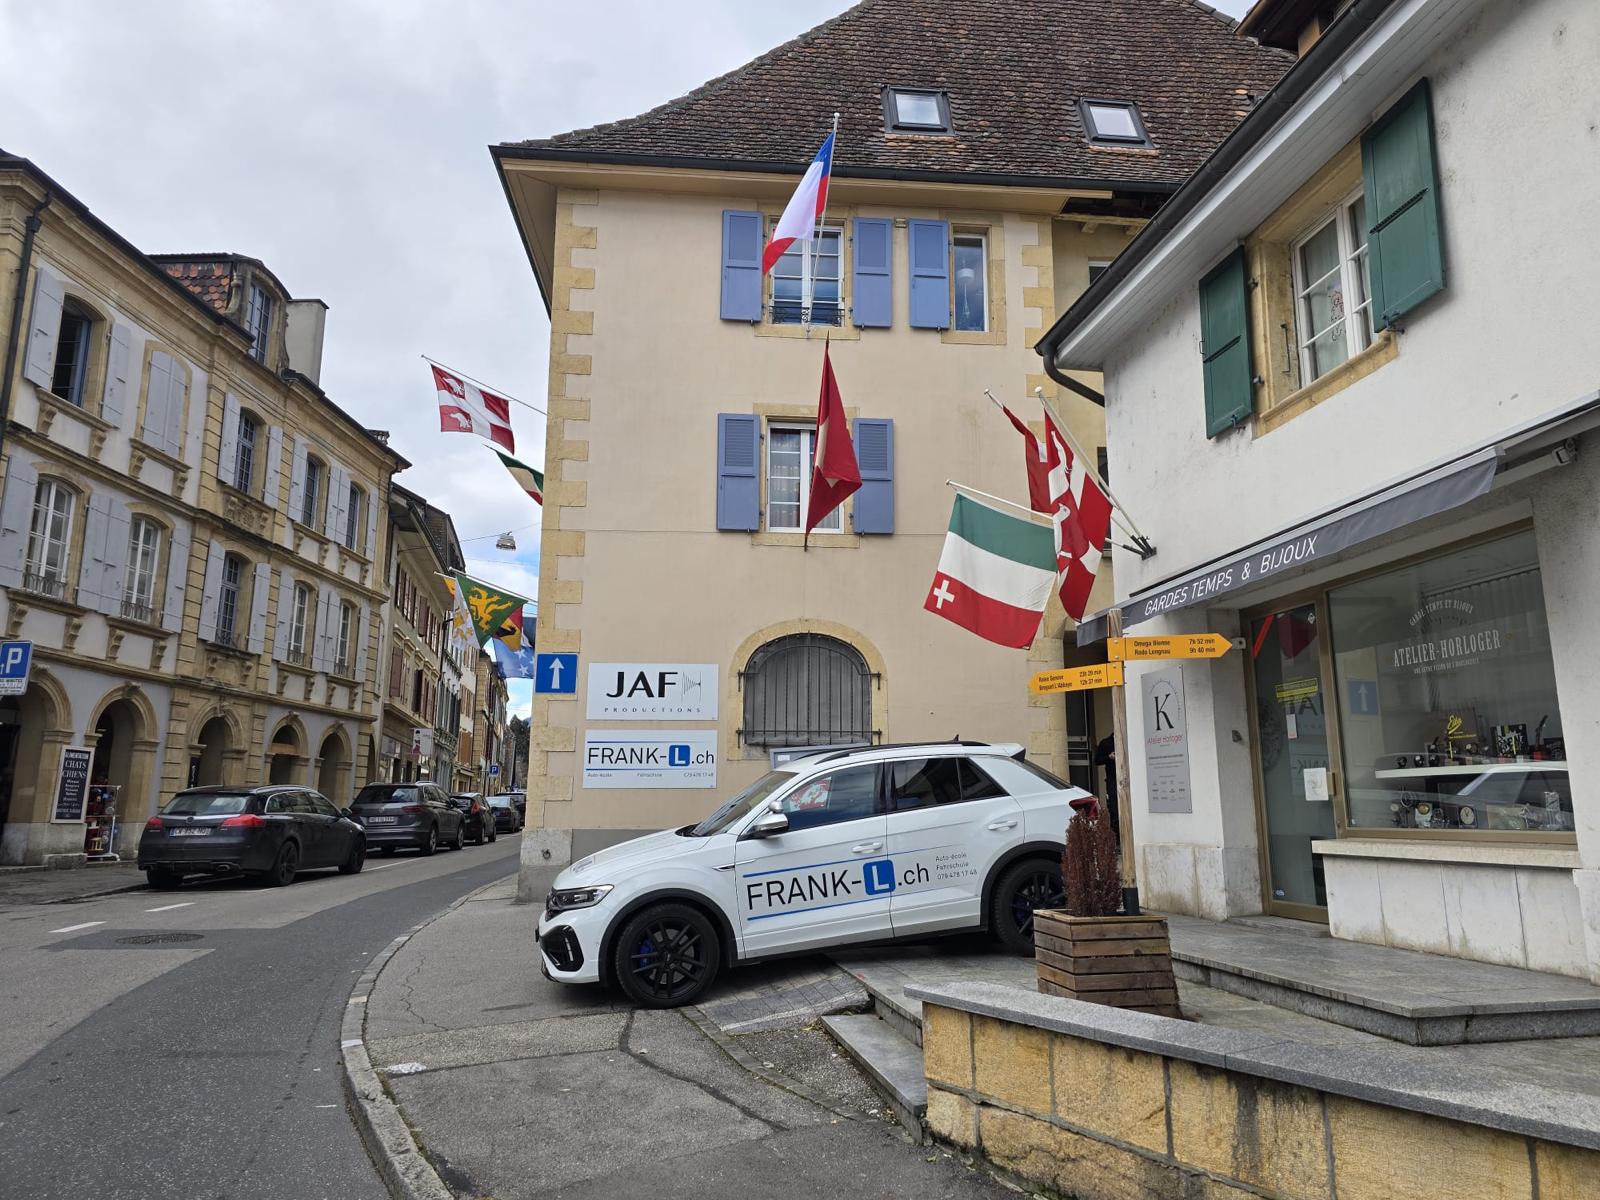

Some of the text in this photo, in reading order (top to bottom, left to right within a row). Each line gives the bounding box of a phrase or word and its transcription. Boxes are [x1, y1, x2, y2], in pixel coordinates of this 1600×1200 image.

[1144, 534, 1318, 616] GARDES TEMPS & BIJOUX
[1425, 600, 1444, 614] TEMPS
[1444, 599, 1452, 609] ET
[1453, 599, 1474, 614] BIJOUX
[1133, 640, 1152, 648] Omega
[1134, 648, 1148, 656] Rado
[1148, 647, 1171, 656] Lengnau
[5, 647, 23, 674] P
[605, 670, 679, 698] JAF
[604, 706, 702, 714] PRODUCTIONS
[1153, 693, 1175, 731] K
[64, 759, 87, 770] CHATS
[62, 770, 87, 779] CHIENS
